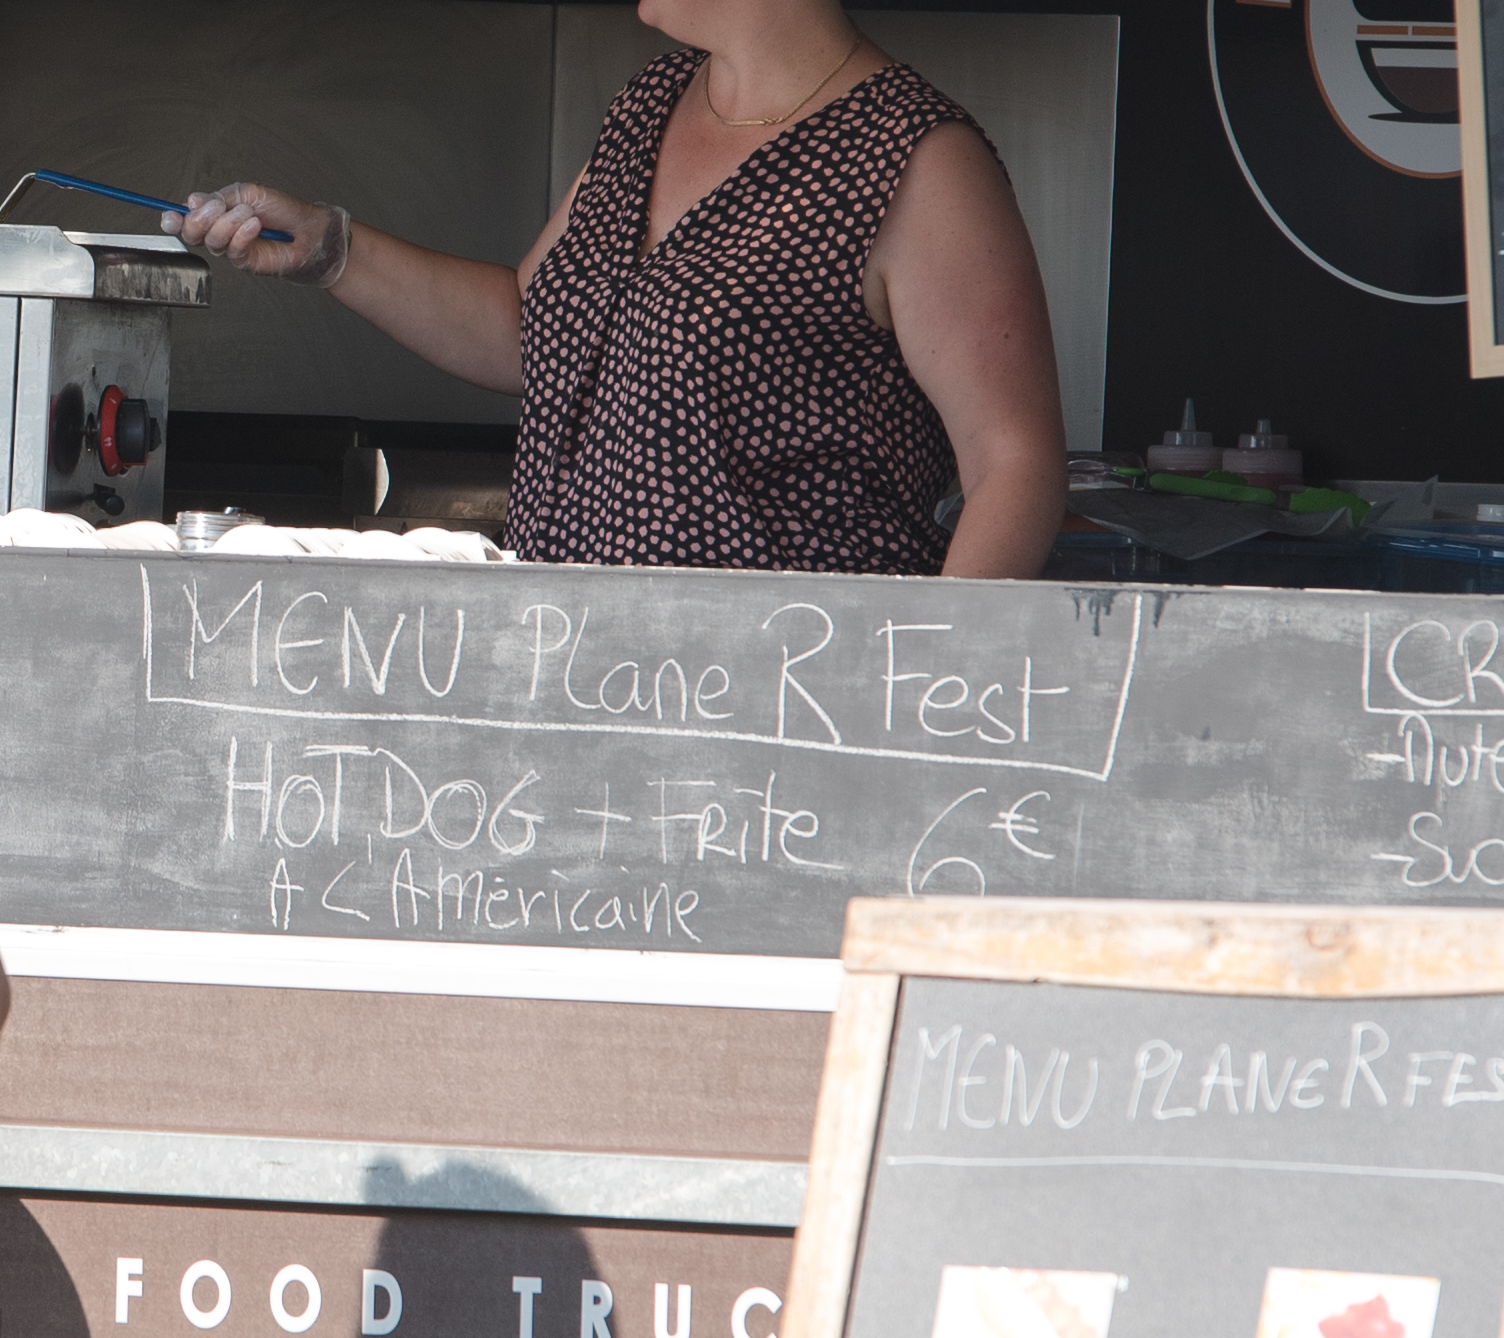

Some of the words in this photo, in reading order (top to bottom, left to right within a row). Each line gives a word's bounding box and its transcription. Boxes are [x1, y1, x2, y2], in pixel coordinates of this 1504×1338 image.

[183, 578, 466, 698] MENU
[522, 603, 734, 722] Plane
[761, 602, 842, 746] R
[876, 618, 1070, 745] Fest
[904, 1023, 1098, 1131] MENU
[114, 1256, 403, 1336] FOOD
